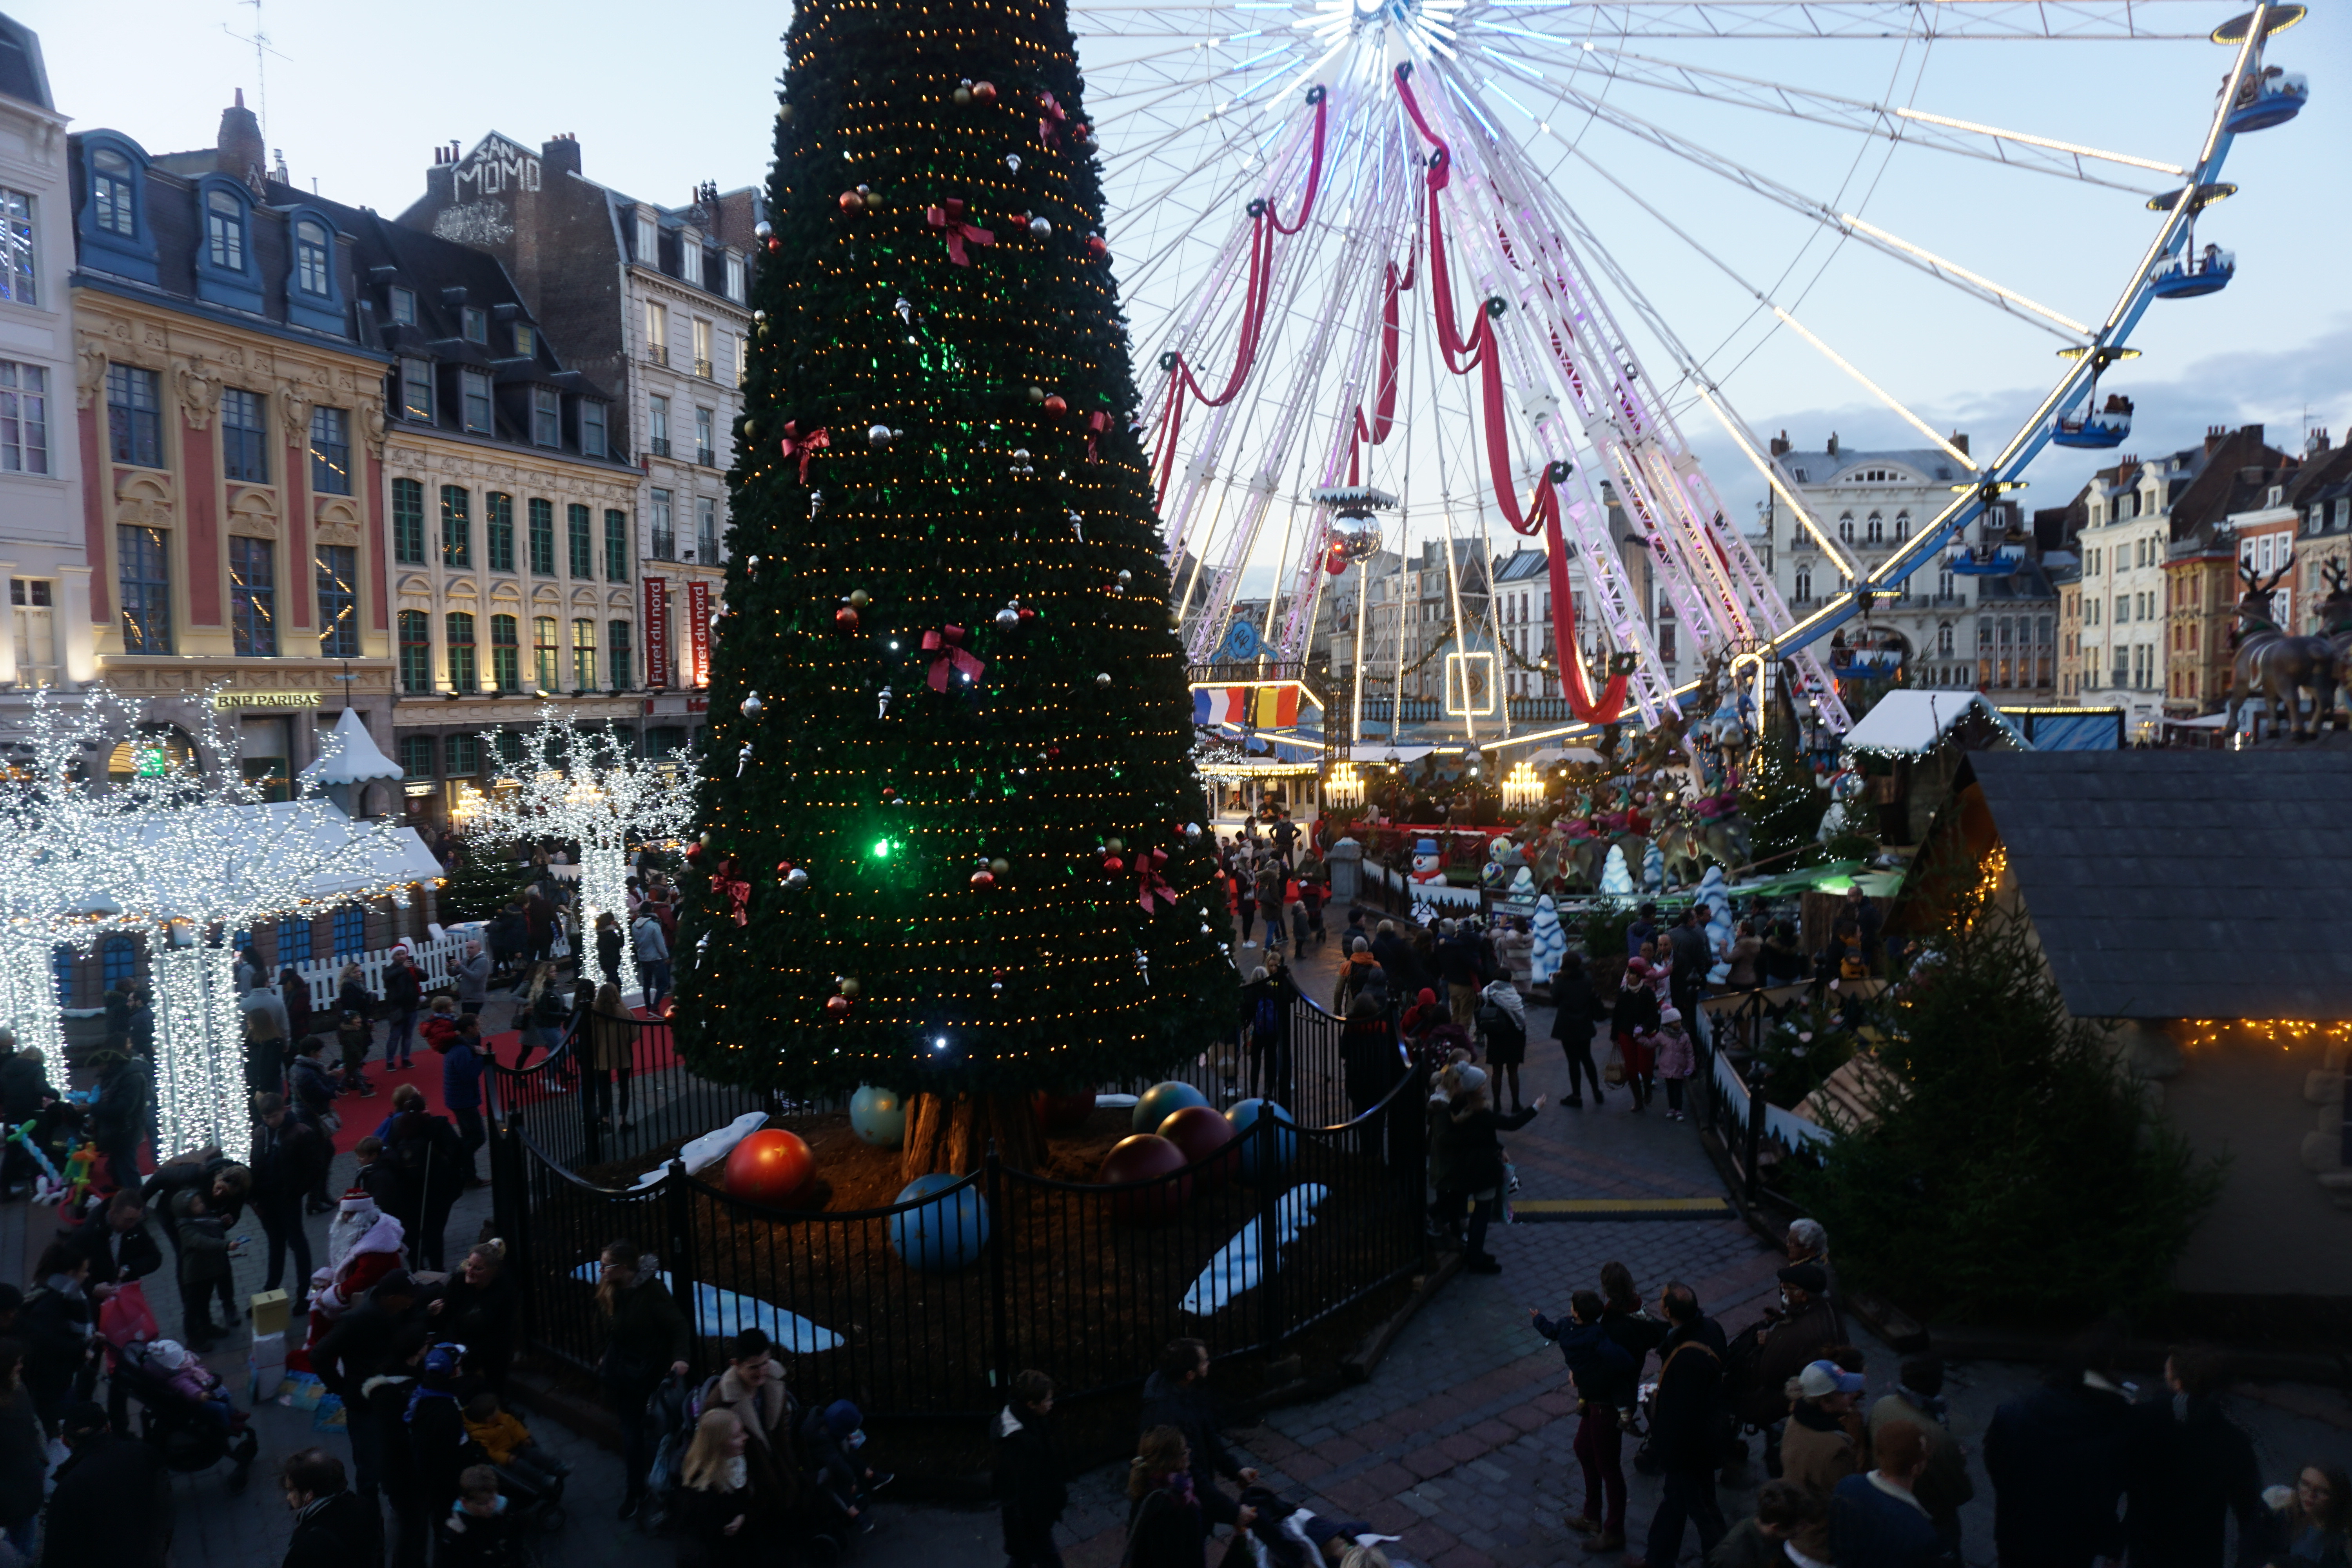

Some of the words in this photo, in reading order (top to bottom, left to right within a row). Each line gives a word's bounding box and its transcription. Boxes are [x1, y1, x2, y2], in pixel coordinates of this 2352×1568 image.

[474, 136, 515, 162] SAN
[453, 157, 541, 202] MOMO
[649, 583, 661, 617] nord
[693, 586, 704, 619] nord
[650, 621, 661, 640] du
[695, 623, 705, 642] du
[652, 643, 663, 682] Furet
[697, 644, 708, 684] Furet
[217, 696, 253, 707] BNP
[256, 695, 321, 706] PARIBAS
[405, 784, 436, 793] voyages
